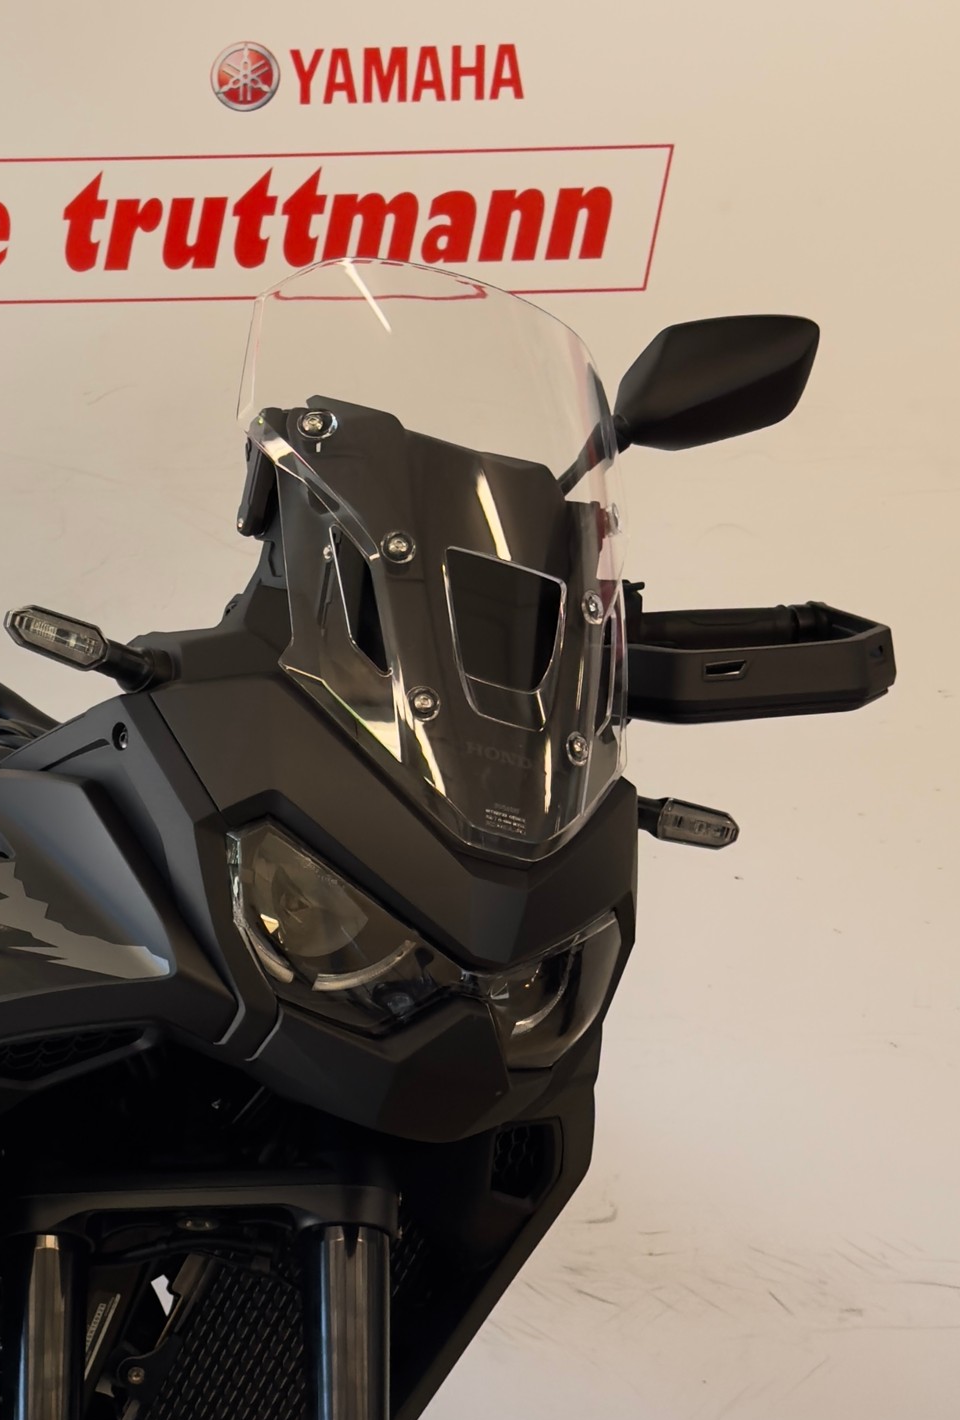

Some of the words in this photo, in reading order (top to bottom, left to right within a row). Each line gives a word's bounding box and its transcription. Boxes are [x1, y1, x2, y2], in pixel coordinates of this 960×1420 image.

[288, 43, 525, 106] YAMAHA
[62, 165, 614, 273] truttmann
[465, 741, 536, 771] HOND
